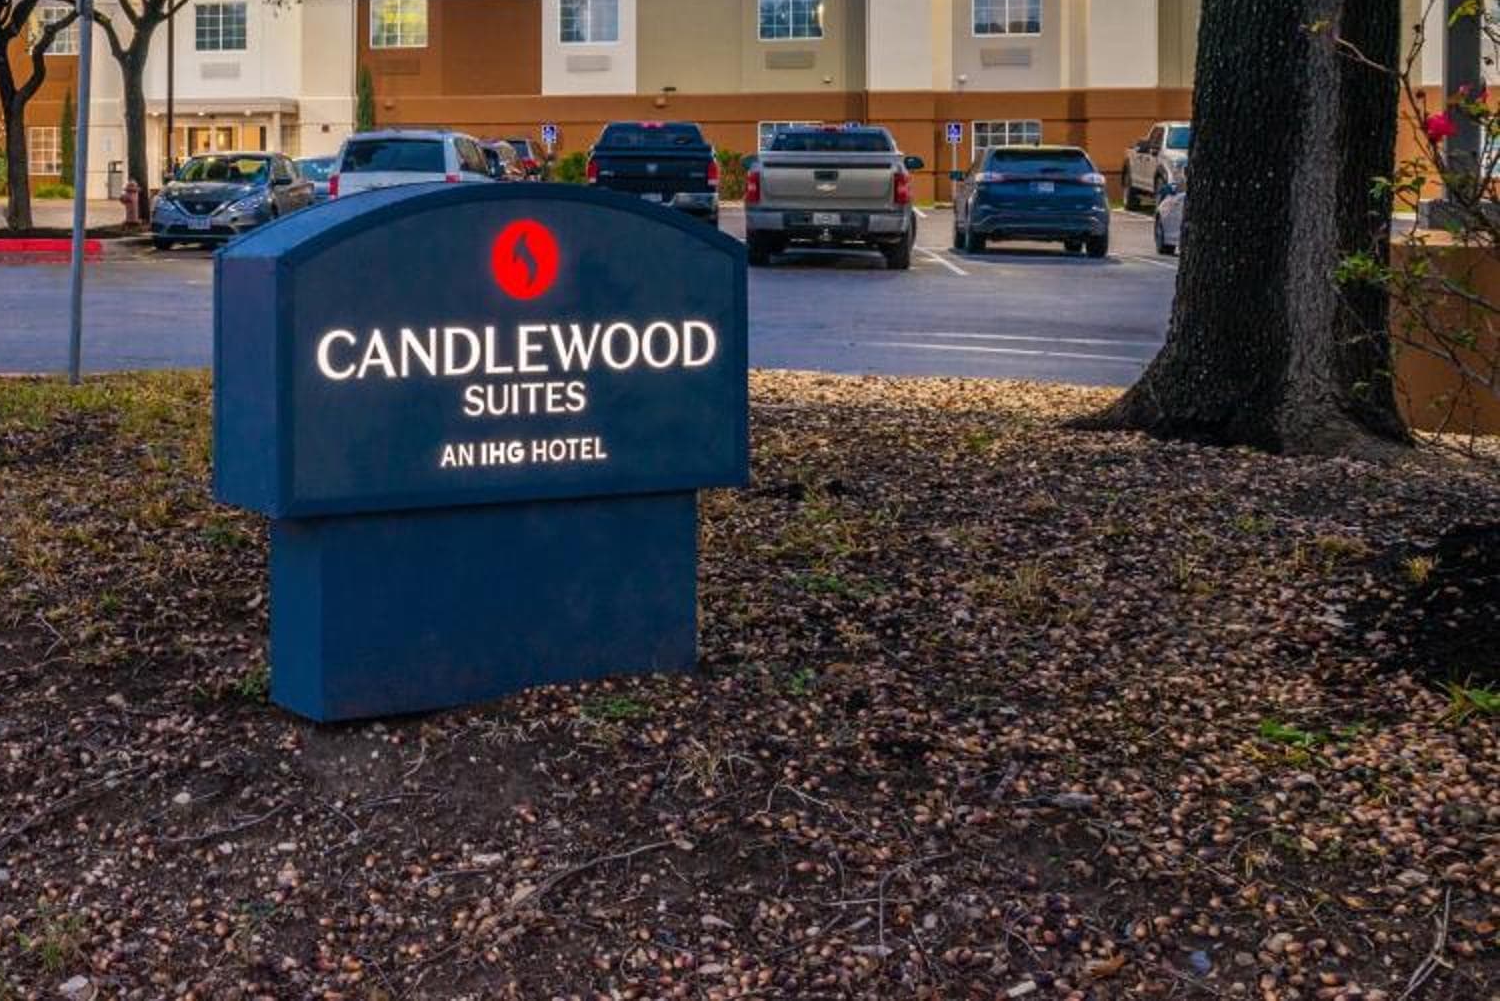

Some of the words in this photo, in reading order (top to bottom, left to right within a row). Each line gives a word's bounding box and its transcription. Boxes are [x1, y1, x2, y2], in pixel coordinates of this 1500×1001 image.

[316, 319, 718, 382] CANDLEWOOD
[463, 380, 587, 417] SUITES
[439, 443, 475, 468] AN
[479, 440, 526, 466] IHG
[531, 436, 608, 464] HOTEL
